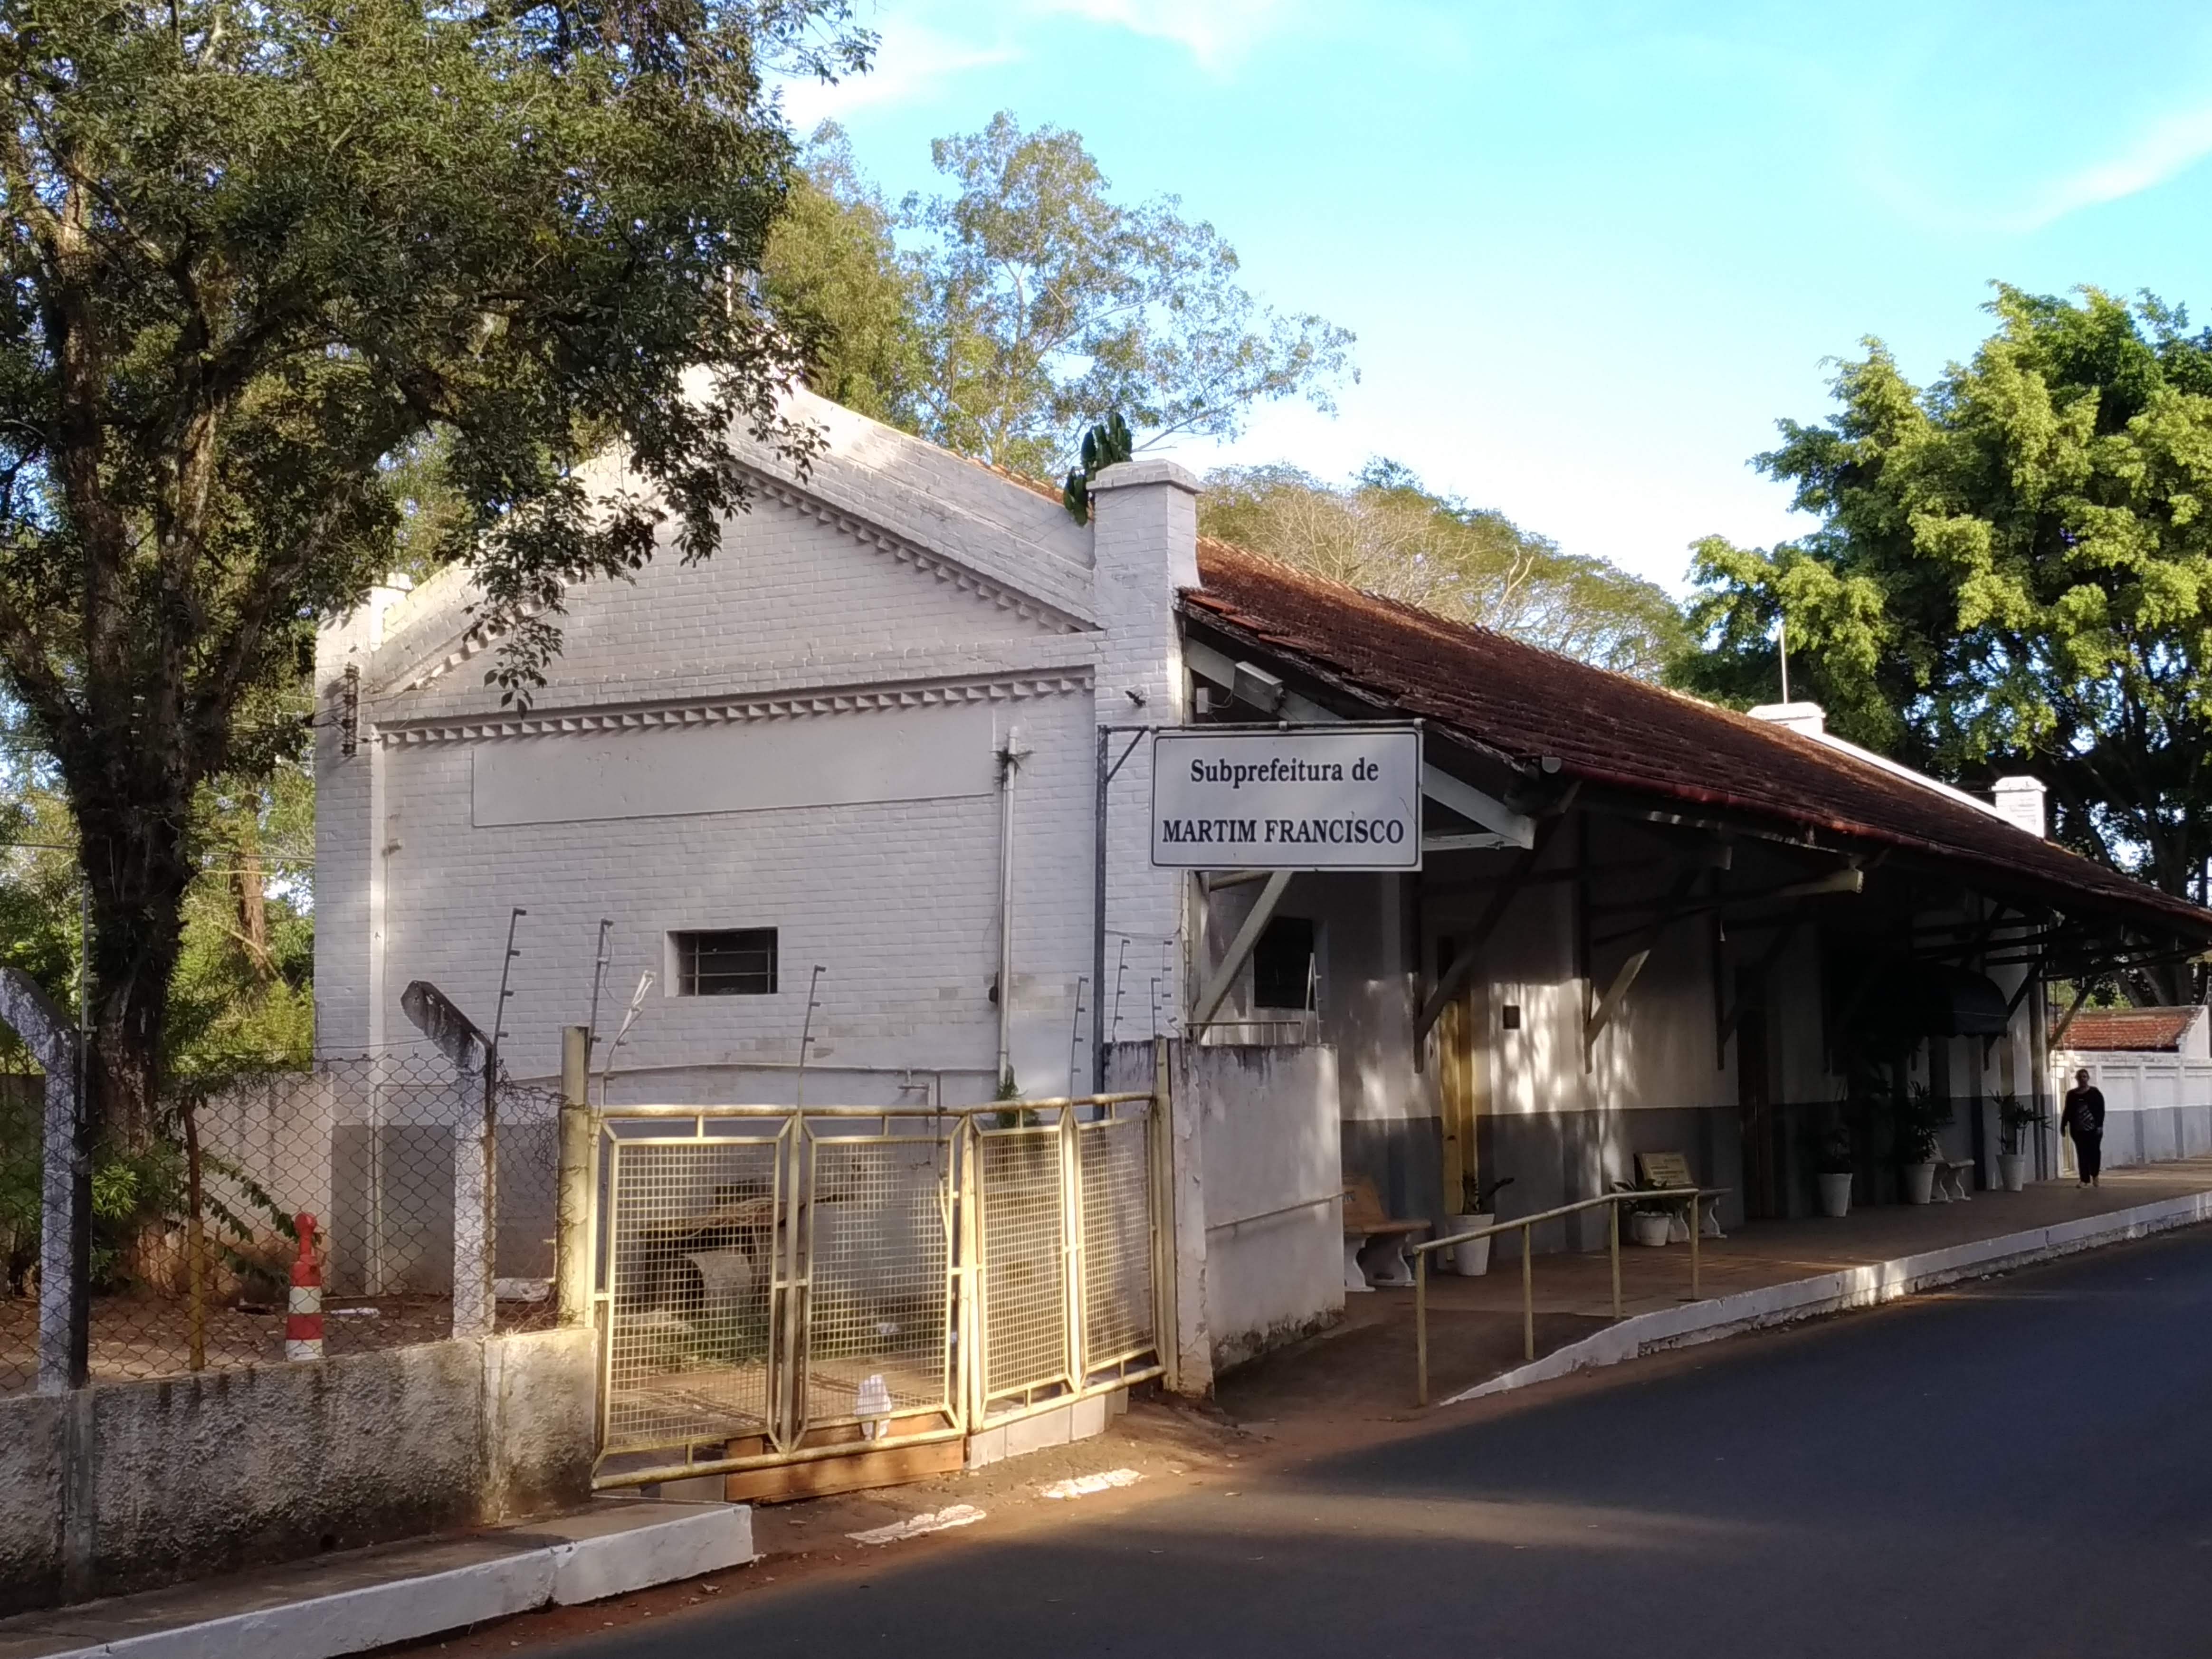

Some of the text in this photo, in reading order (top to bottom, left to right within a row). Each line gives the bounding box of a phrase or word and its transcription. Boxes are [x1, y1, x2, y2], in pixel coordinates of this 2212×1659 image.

[1191, 757, 1379, 789] Subprefeitura de
[1163, 819, 1404, 844] MARTIM FRANCISCO
